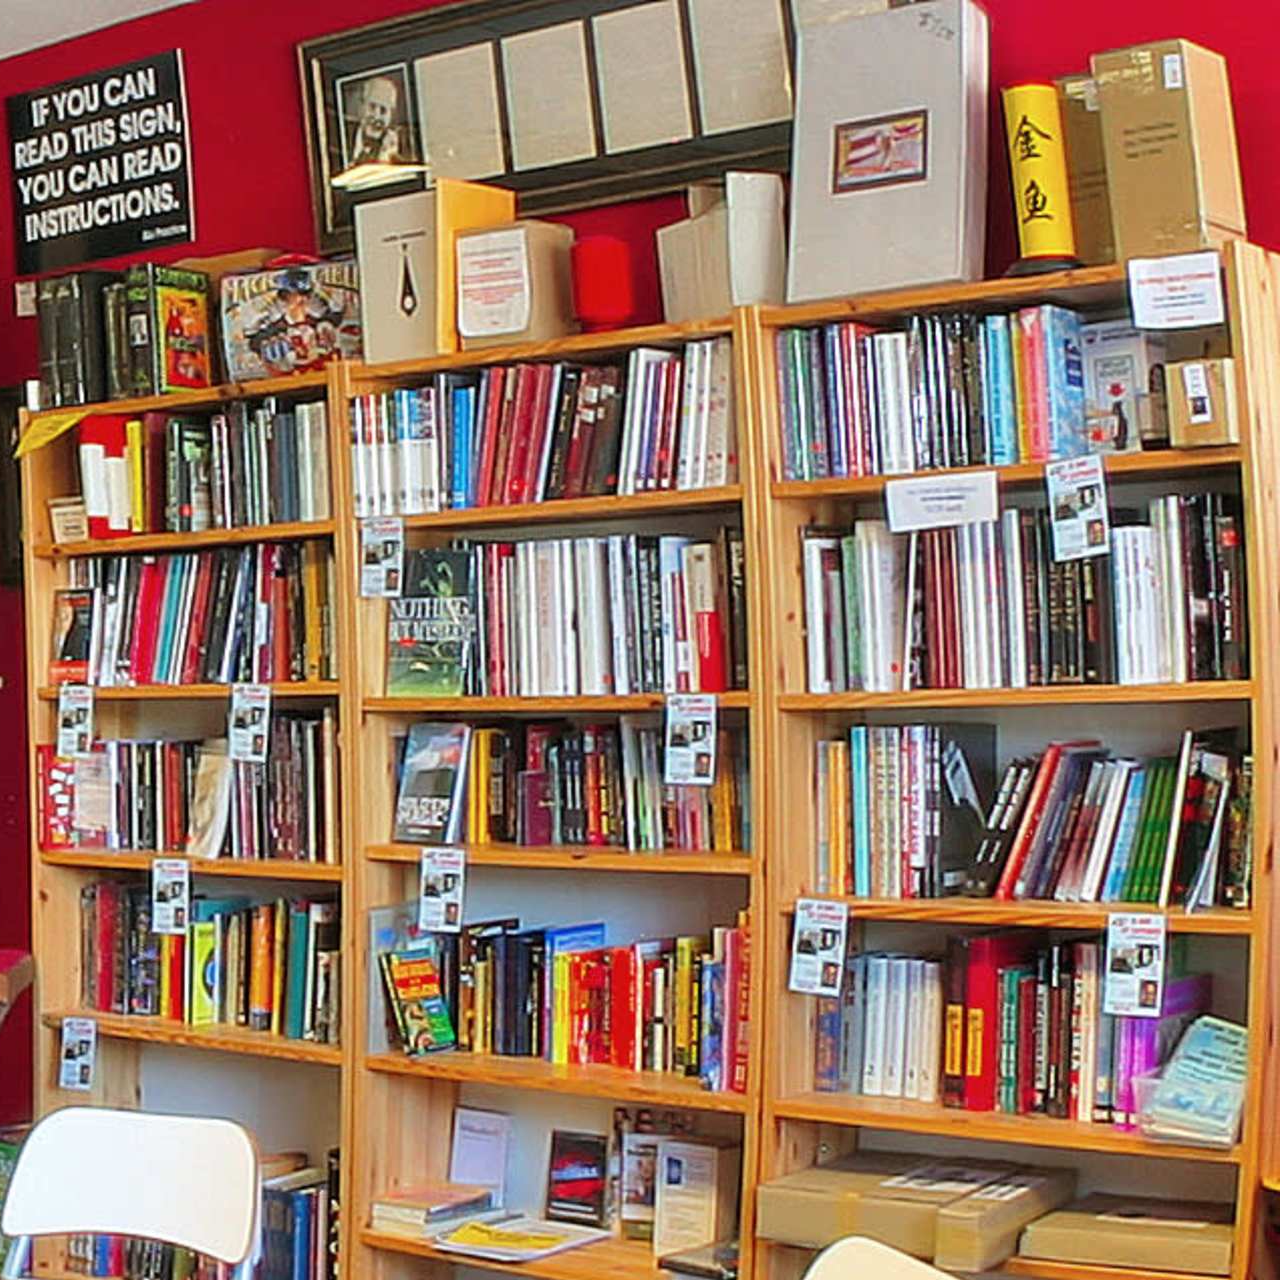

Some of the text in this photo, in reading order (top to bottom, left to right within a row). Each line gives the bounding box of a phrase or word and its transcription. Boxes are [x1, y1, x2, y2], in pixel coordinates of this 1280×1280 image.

[31, 68, 157, 128] IF YOU CAN
[14, 102, 182, 170] READ THIS SIGN,
[17, 142, 182, 205] YOU CAN READ
[24, 182, 181, 243] INSTRUCTIONS.
